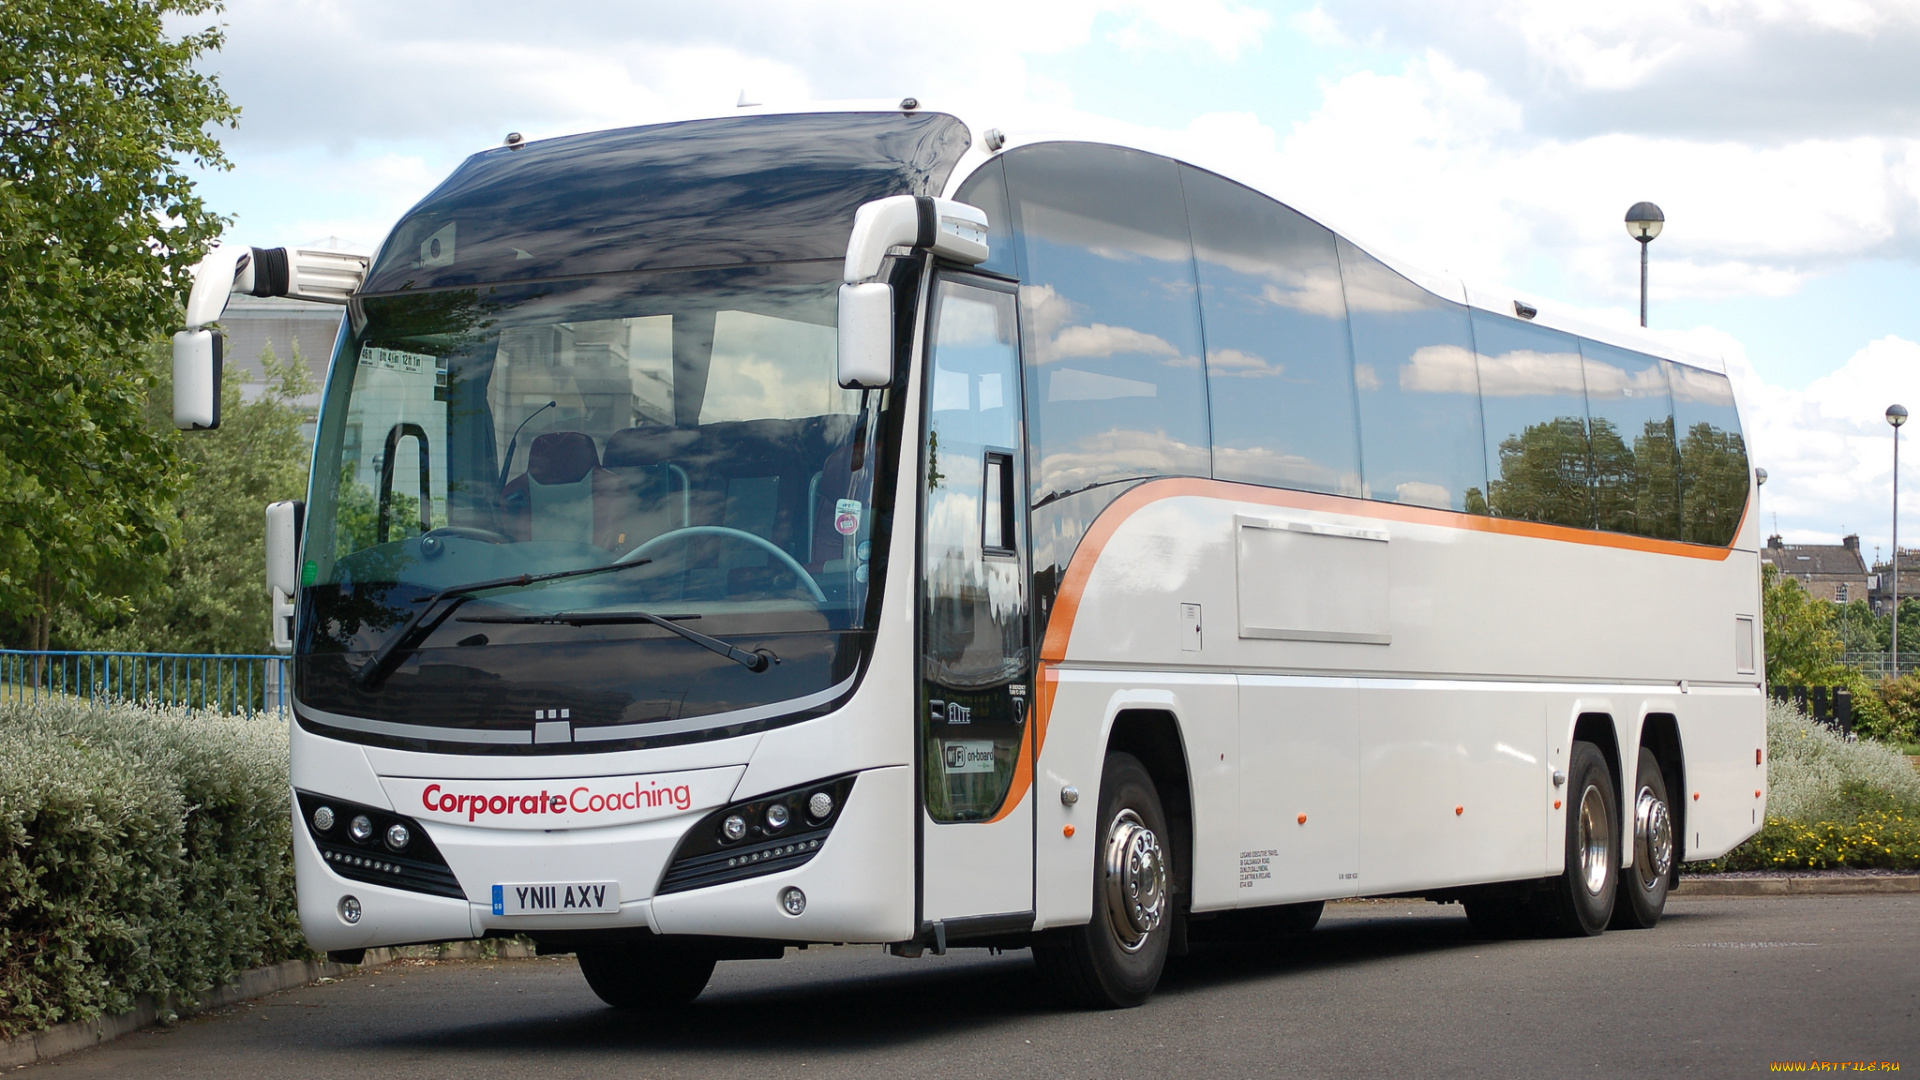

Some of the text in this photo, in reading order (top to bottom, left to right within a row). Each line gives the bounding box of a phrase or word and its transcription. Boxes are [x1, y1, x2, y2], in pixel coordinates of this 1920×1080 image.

[948, 703, 971, 722] ELITE
[967, 748, 994, 762] on-board
[422, 781, 691, 822] Corporate Coaching
[563, 885, 606, 908] AXV
